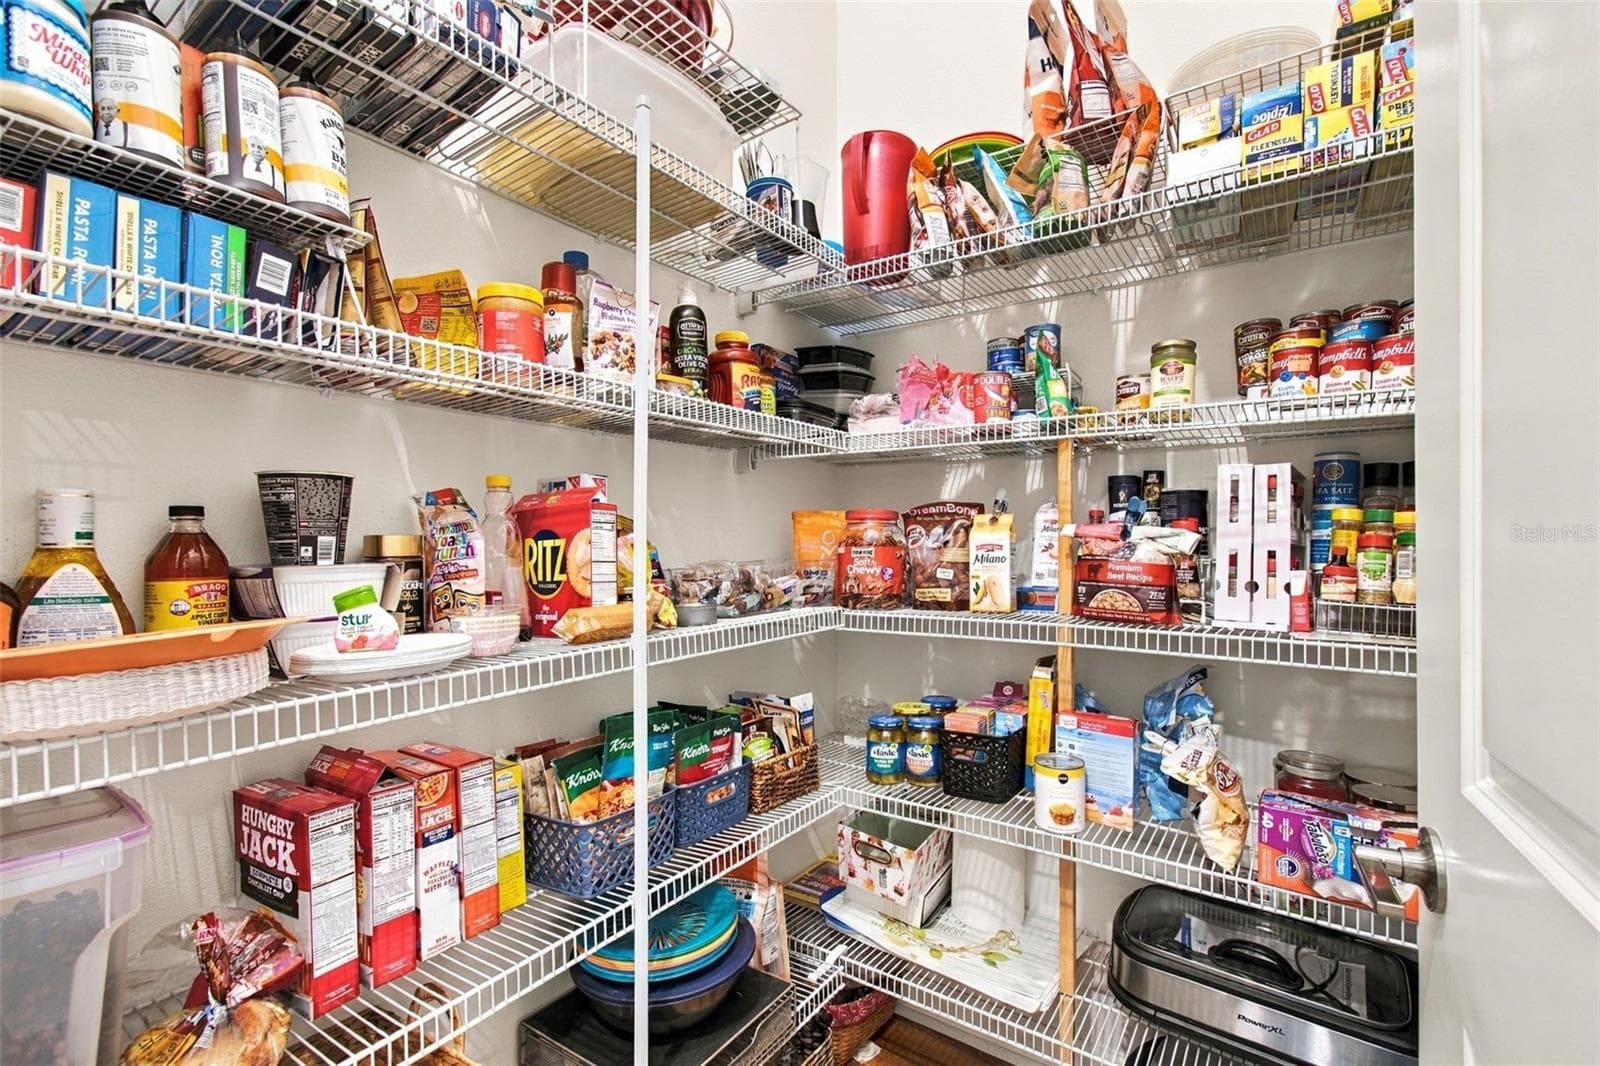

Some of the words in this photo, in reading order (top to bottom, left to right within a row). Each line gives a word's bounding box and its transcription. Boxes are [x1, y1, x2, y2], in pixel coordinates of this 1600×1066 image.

[45, 45, 90, 86] Whip
[1310, 85, 1323, 112] GLAD
[1386, 86, 1414, 101] GLA
[1252, 102, 1293, 124] Ziploc
[1388, 100, 1414, 112] PRES
[1397, 107, 1414, 116] SEA
[1352, 108, 1368, 138] GLAD
[1248, 122, 1280, 141] GLAD
[73, 197, 91, 241] PASTA
[143, 218, 157, 260] PASTA
[1237, 331, 1270, 344] CHUNKY
[741, 374, 761, 389] RAG
[1331, 487, 1353, 495] SALT
[1041, 524, 1059, 533] Mila
[524, 538, 568, 585] RITZ
[854, 557, 872, 567] Soft
[972, 553, 1007, 566] Milano
[847, 565, 881, 577] Chewy
[1108, 563, 1143, 572] Premium
[1107, 572, 1124, 580] Beef
[1126, 573, 1153, 584] Recipe
[401, 590, 418, 598] OLD
[341, 613, 373, 627] stur
[609, 737, 635, 752] Kno
[681, 744, 710, 760] Knorr
[566, 768, 602, 790] Knorr
[241, 804, 295, 841] HUNGRY
[240, 824, 297, 876] JACK
[1237, 1013, 1286, 1036] PowerXL
